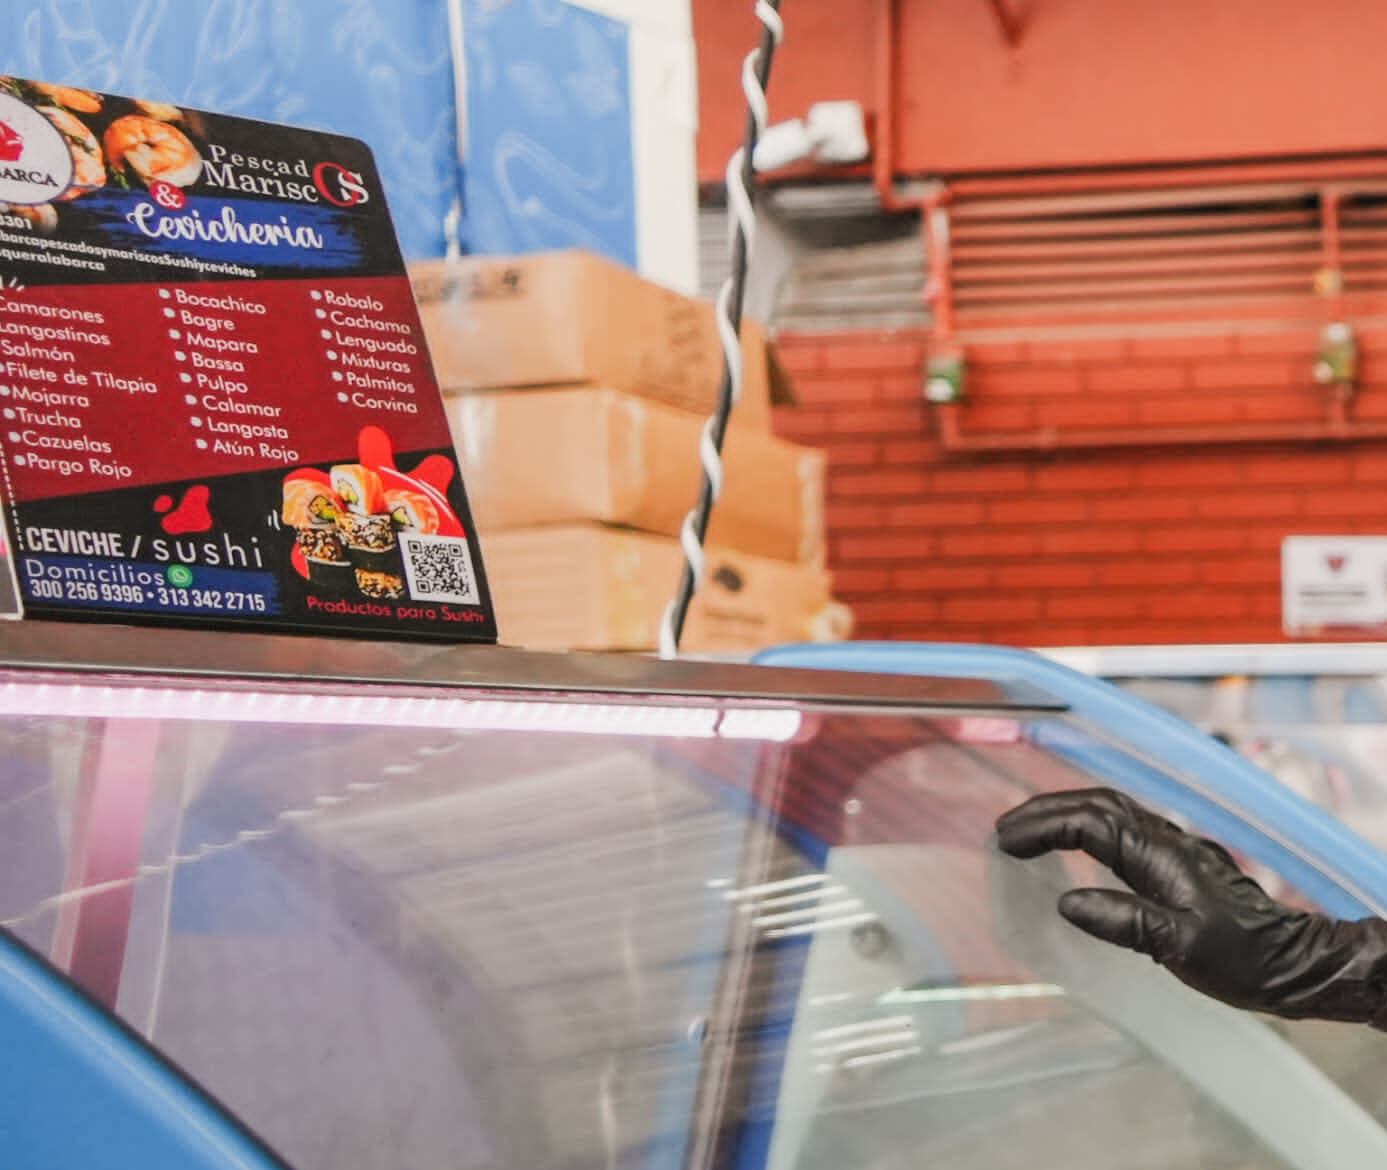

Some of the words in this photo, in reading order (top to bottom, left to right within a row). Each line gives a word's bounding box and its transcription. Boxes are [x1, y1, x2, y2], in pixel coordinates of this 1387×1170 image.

[0, 167, 59, 187] ARCA
[156, 184, 183, 209] &
[126, 203, 323, 248] Cevicheria
[0, 248, 106, 272] queralabarca
[175, 288, 267, 315] Bocachico
[324, 289, 384, 312] Robalo
[180, 310, 236, 332] Bagre
[330, 311, 411, 335] Cachama
[1, 339, 75, 362] Salmón
[186, 331, 259, 355] Mapara
[335, 331, 418, 356] Lenguado
[191, 351, 245, 373] Bassa
[341, 352, 411, 374] Mixturas
[6, 362, 57, 383] Filete
[63, 368, 89, 386] de
[91, 371, 158, 394] Tilapia
[197, 373, 249, 395] Pulpo
[346, 372, 416, 395] Palmitos
[12, 385, 90, 407] Mojarra
[202, 394, 283, 418] Calamar
[351, 392, 419, 414] Corvina
[15, 406, 82, 428] Trucha
[207, 416, 289, 439] Langosta
[22, 430, 113, 453] Cazuelas
[213, 438, 255, 458] Atún
[259, 442, 299, 464] Rojo
[27, 452, 84, 476] Pargo
[88, 458, 133, 480] Rojo
[26, 526, 126, 558] CEVICHE
[152, 533, 264, 569] sushi
[25, 558, 166, 586] Domicilios
[31, 580, 64, 599] 300
[66, 581, 98, 601] 256
[101, 583, 144, 603] 9396
[159, 587, 190, 607] 313
[193, 589, 224, 609] 342
[226, 591, 266, 612] 2715
[306, 595, 391, 617] Productos
[396, 605, 437, 621] para
[440, 605, 485, 624] Sushi
